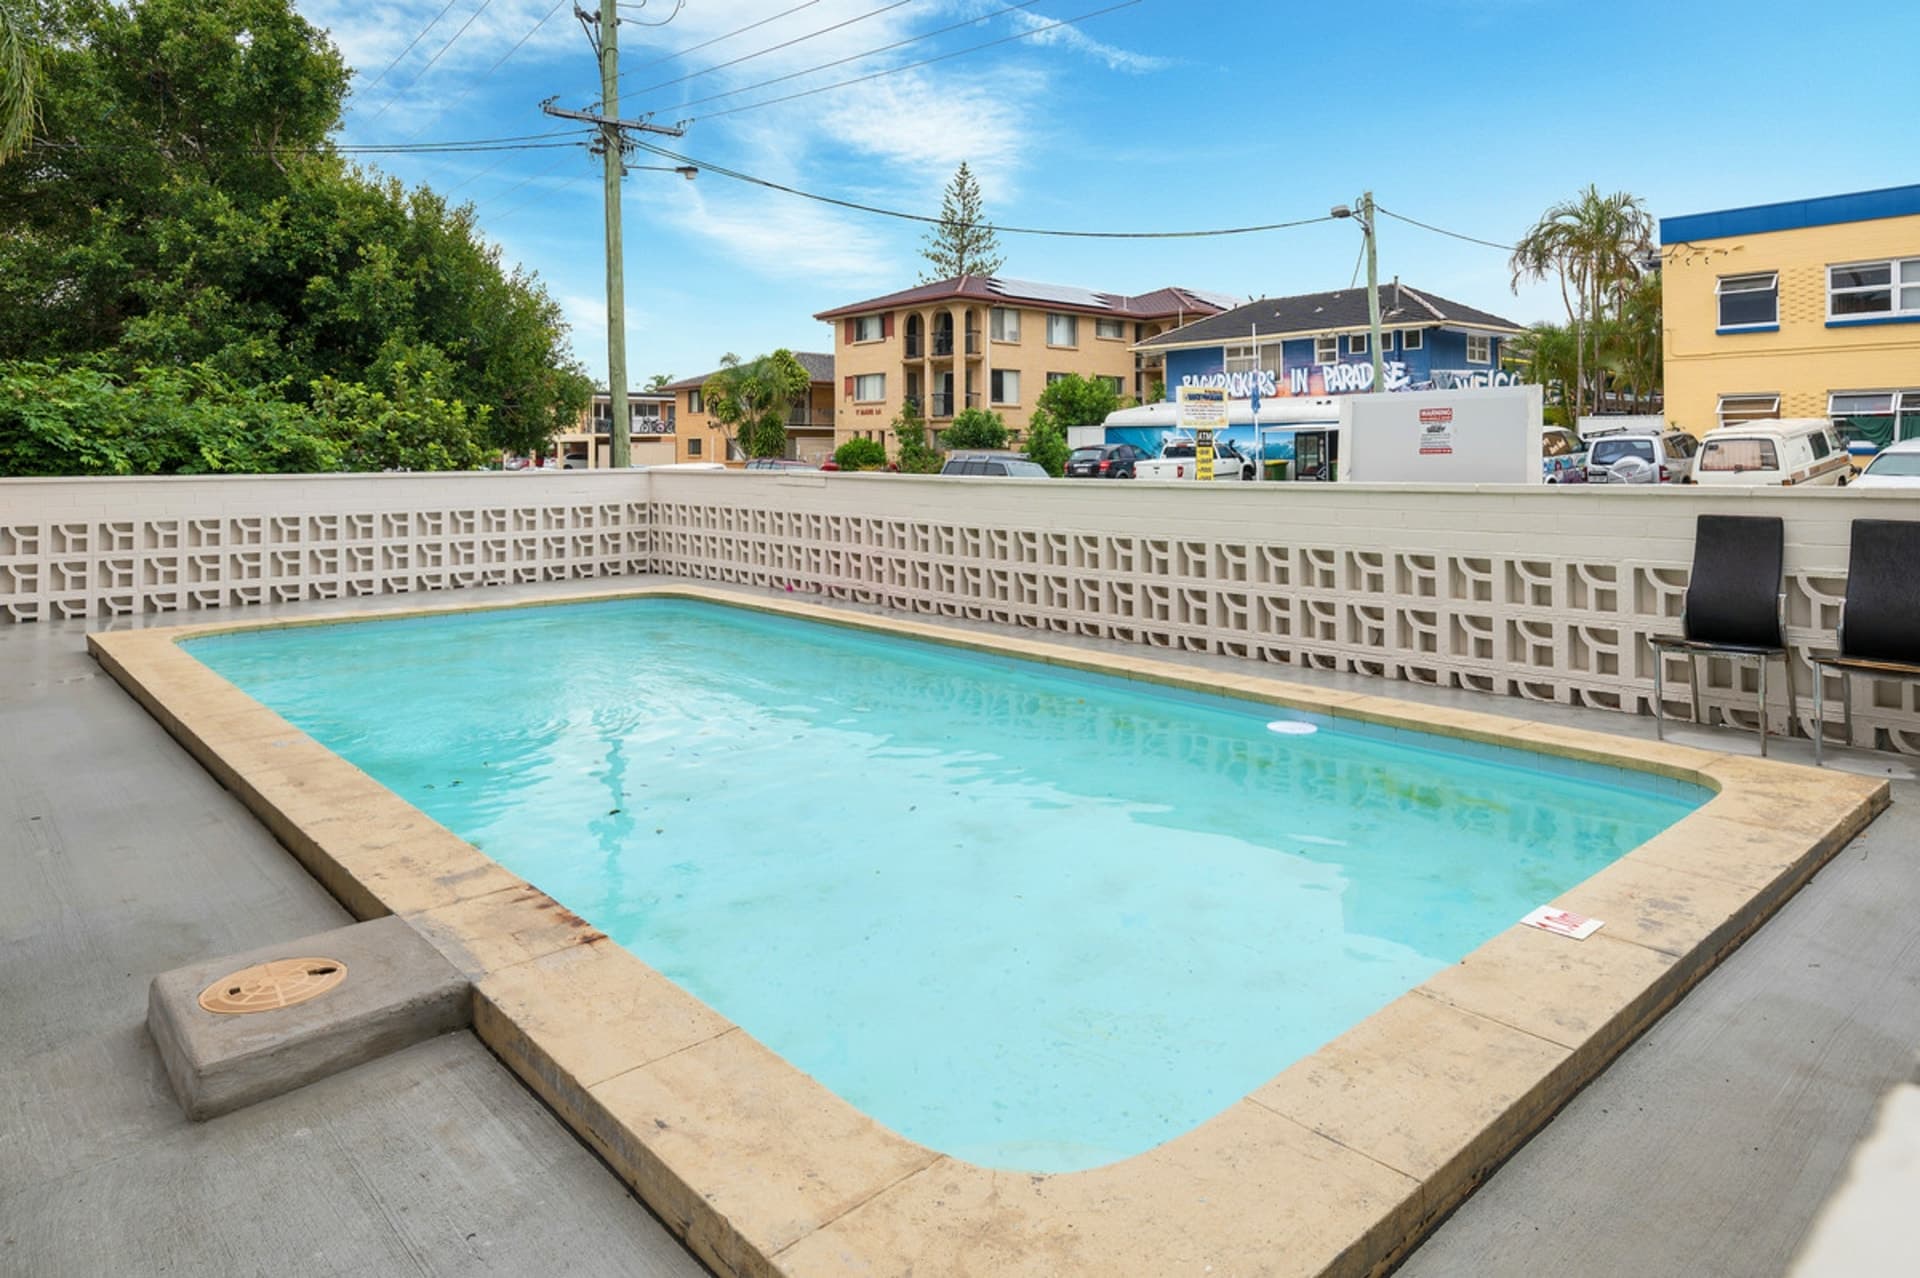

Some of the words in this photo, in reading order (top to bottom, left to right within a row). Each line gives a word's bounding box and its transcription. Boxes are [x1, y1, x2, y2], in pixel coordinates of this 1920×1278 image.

[1290, 367, 1309, 395] IN
[1323, 361, 1411, 393] PARADSE
[1199, 431, 1212, 440] ATM
